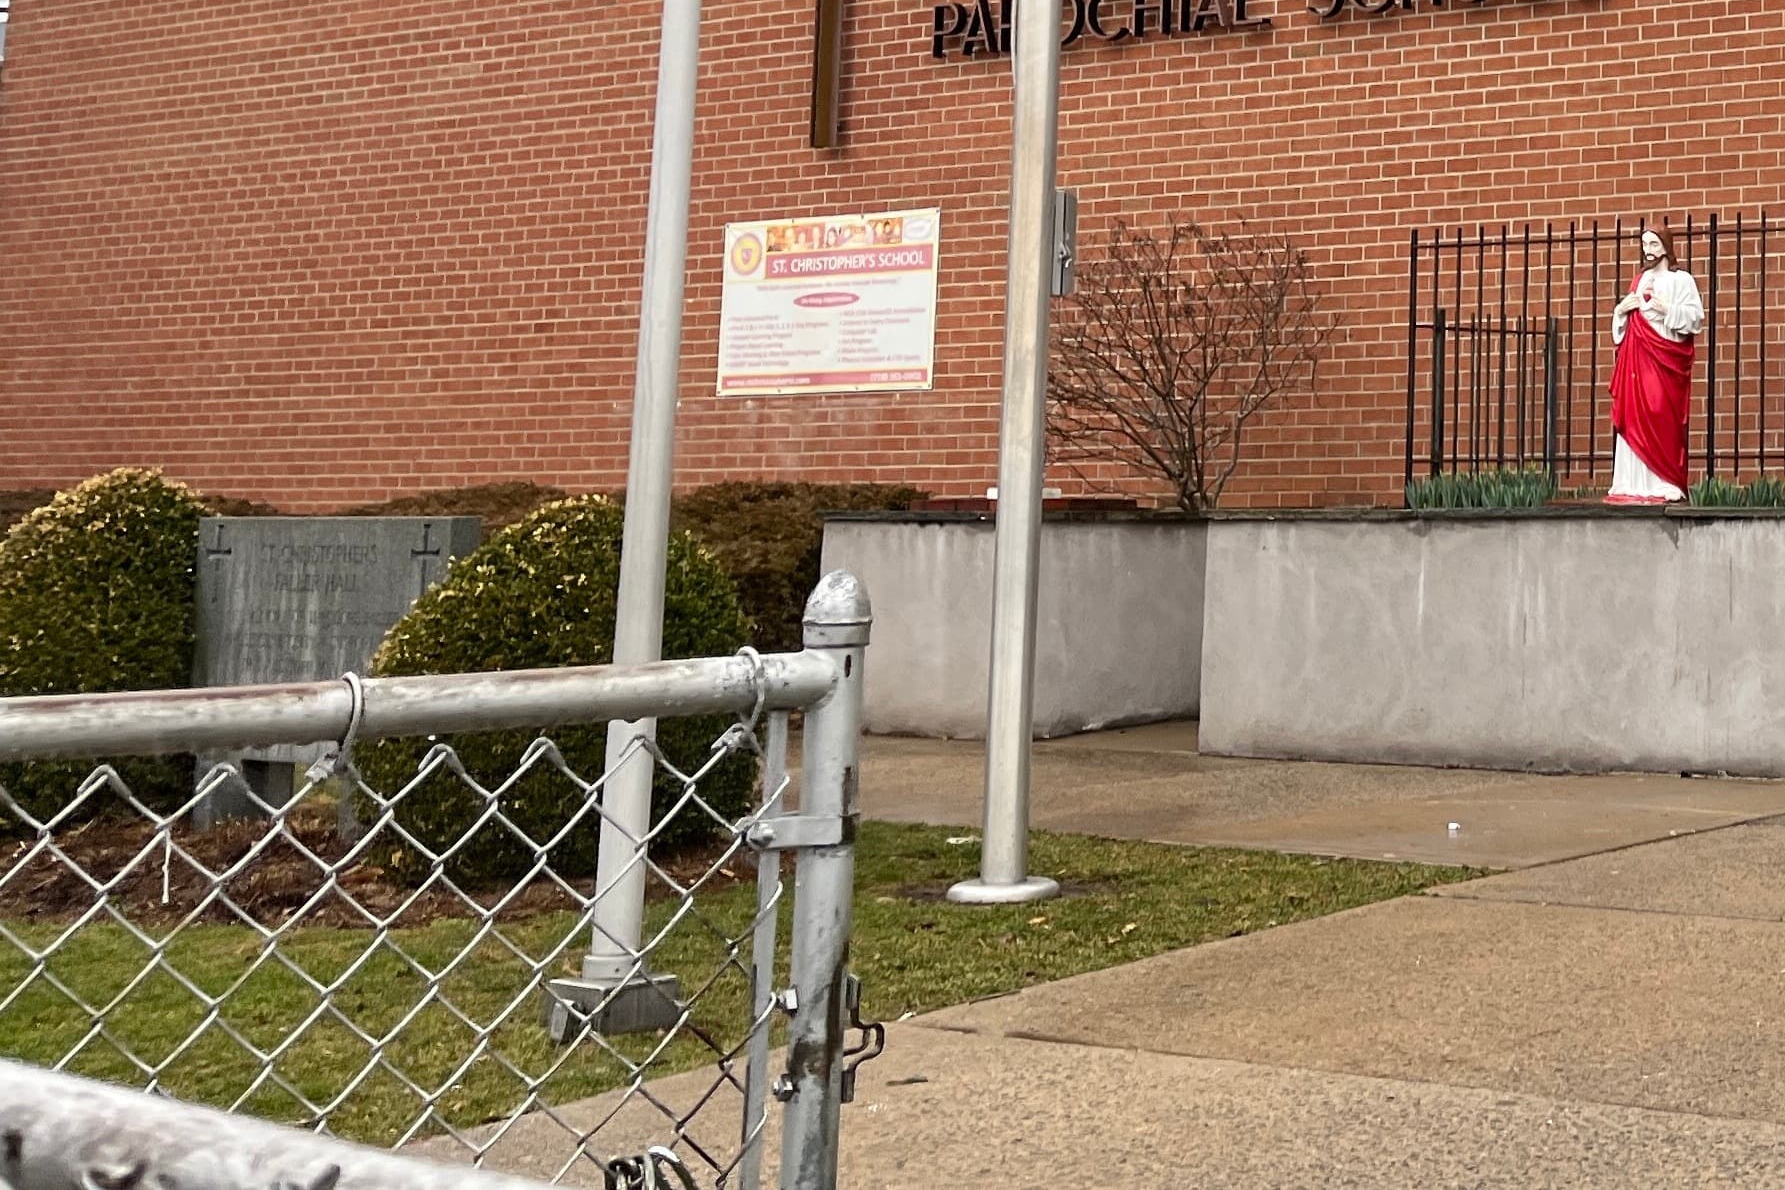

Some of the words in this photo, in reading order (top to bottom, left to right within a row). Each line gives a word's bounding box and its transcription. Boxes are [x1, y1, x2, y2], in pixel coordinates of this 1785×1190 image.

[771, 258, 787, 274] ST.
[790, 252, 876, 273] CHRISTOPHER'S
[878, 249, 925, 268] SCHOOL
